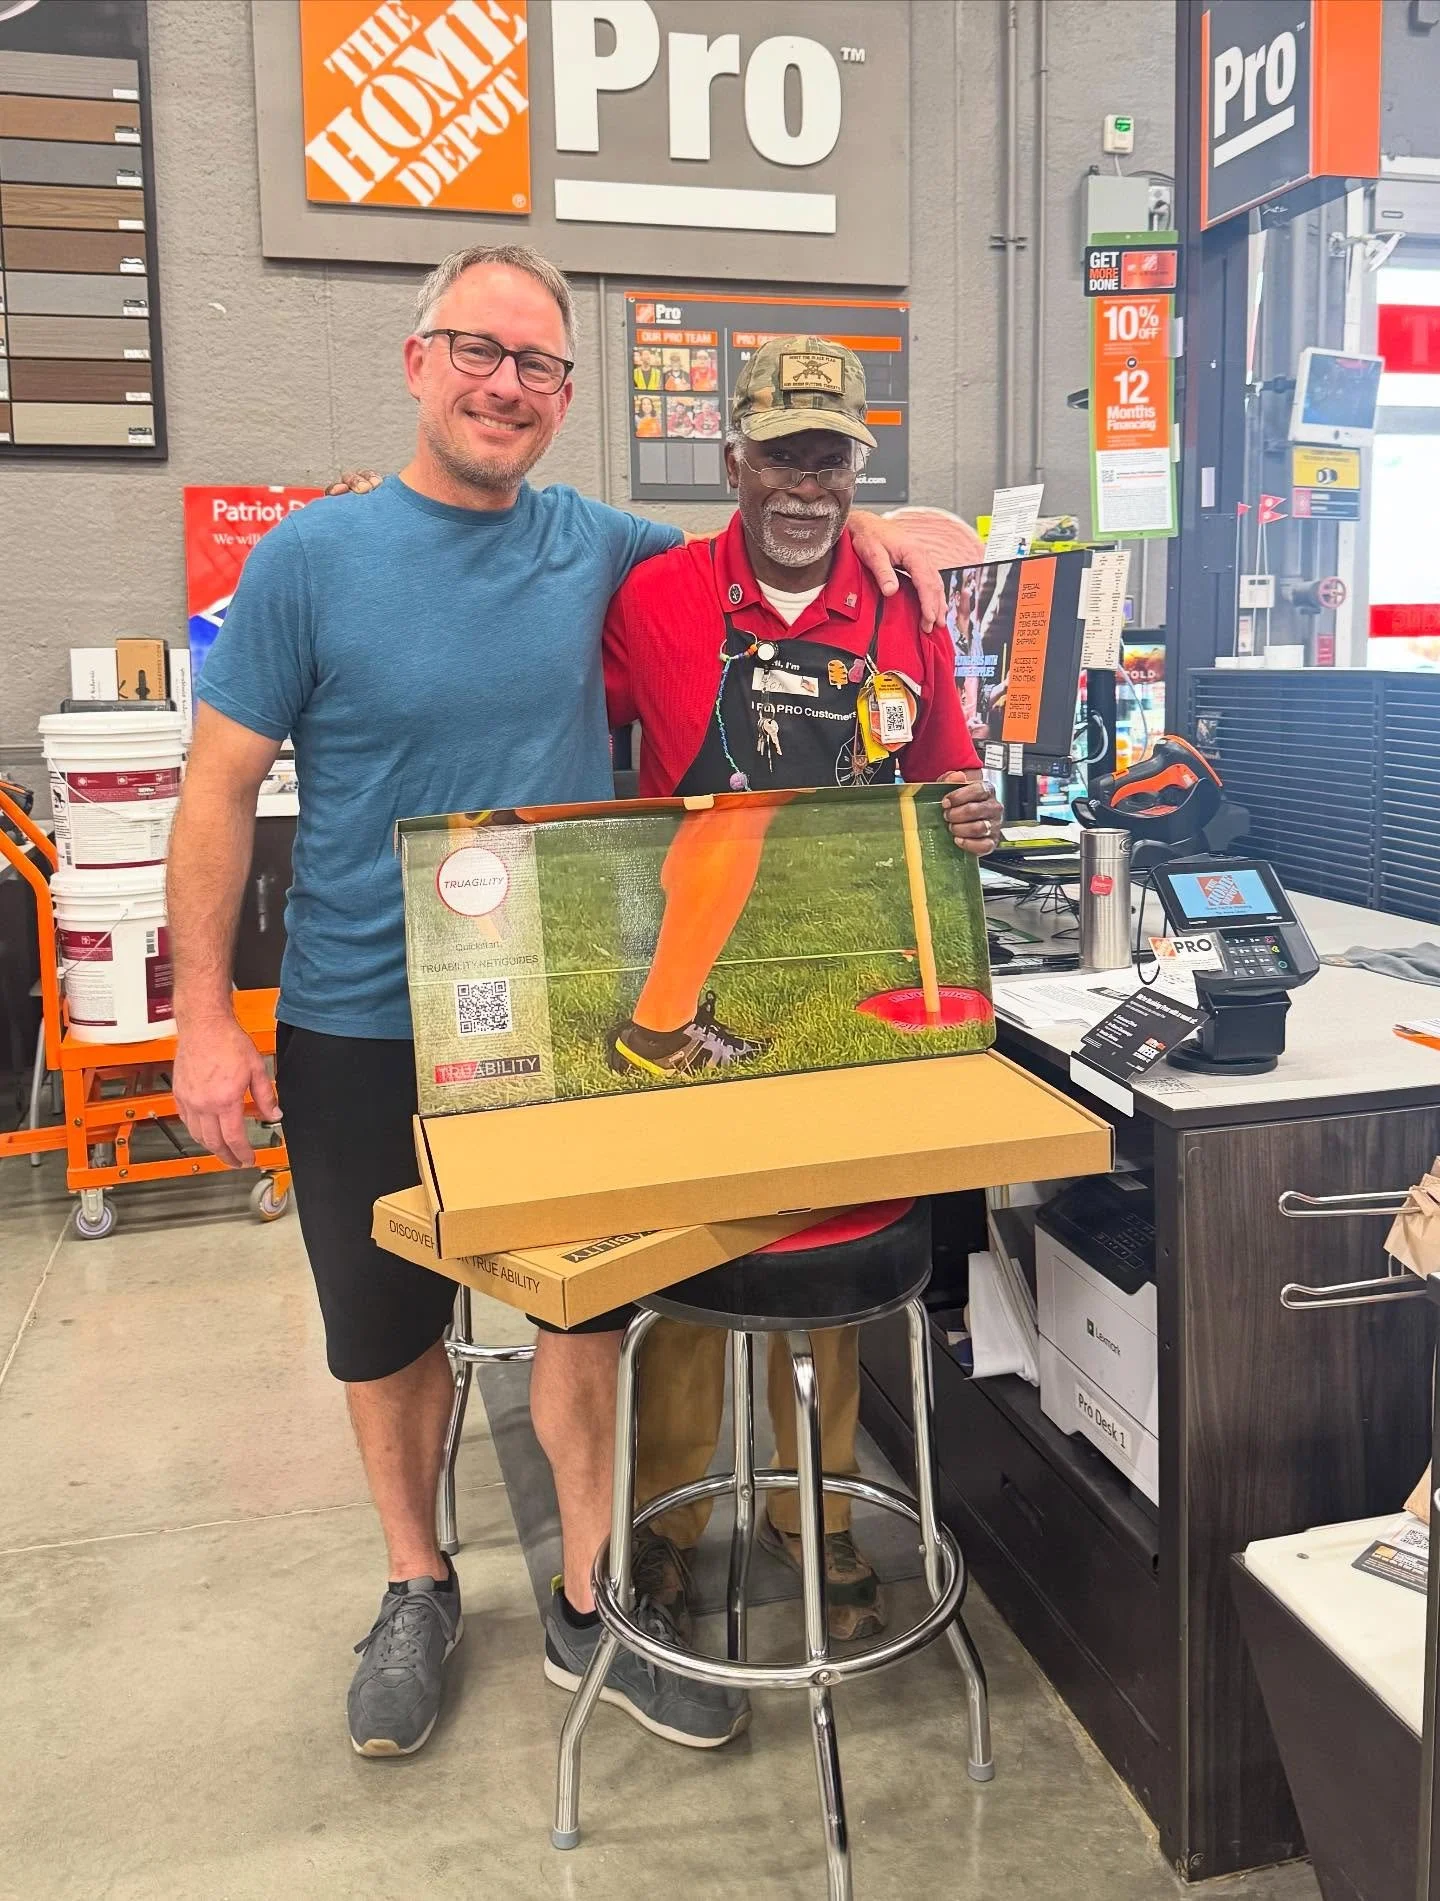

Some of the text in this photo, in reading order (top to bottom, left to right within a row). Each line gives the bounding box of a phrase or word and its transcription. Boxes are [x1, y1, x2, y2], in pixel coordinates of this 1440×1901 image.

[323, 0, 421, 87] THE
[551, 0, 842, 166] Pro
[1214, 31, 1297, 139] Pro
[305, 0, 528, 203] HOME
[395, 66, 529, 207] DEPOT
[1090, 252, 1119, 268] GET
[1089, 268, 1119, 279] MORE
[1089, 279, 1119, 291] DONE
[656, 304, 682, 320] Pro
[663, 333, 683, 343] PRO
[685, 334, 713, 344] TEAM
[736, 335, 756, 346] PRO
[1139, 327, 1161, 339] OFF
[1113, 369, 1150, 404] 12
[1107, 405, 1156, 420] Months
[1107, 420, 1157, 431] Financing
[212, 499, 284, 522] Patriot
[213, 533, 234, 545] We
[785, 661, 801, 671] I'm
[777, 704, 803, 715] PRO
[804, 707, 857, 722] Customers
[443, 877, 505, 889] TRUAGILITY
[1173, 938, 1212, 954] PRO
[500, 1268, 540, 1294] ABILITY
[1095, 1327, 1121, 1357] Lexmark
[1077, 1392, 1126, 1449] Pro Desk 1
